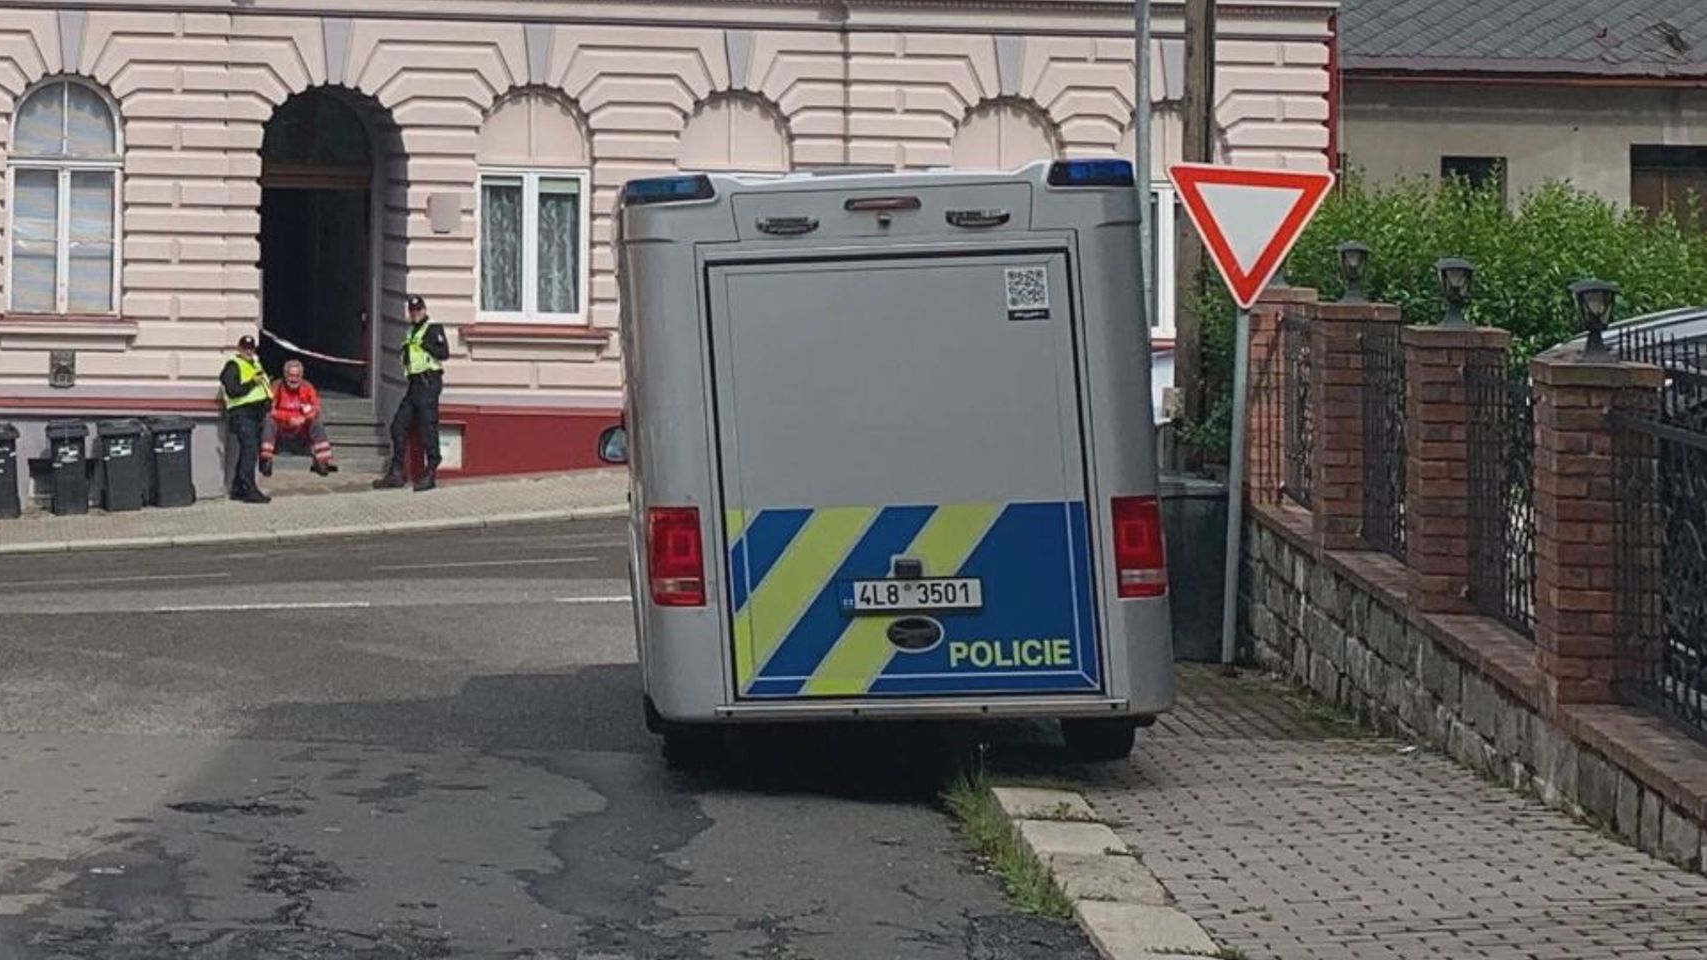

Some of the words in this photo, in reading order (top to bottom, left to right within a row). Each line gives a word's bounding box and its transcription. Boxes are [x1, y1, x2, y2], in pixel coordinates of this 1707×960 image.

[859, 583, 900, 605] 4L8
[917, 581, 971, 604] 3501
[949, 640, 1072, 667] POLICIE
